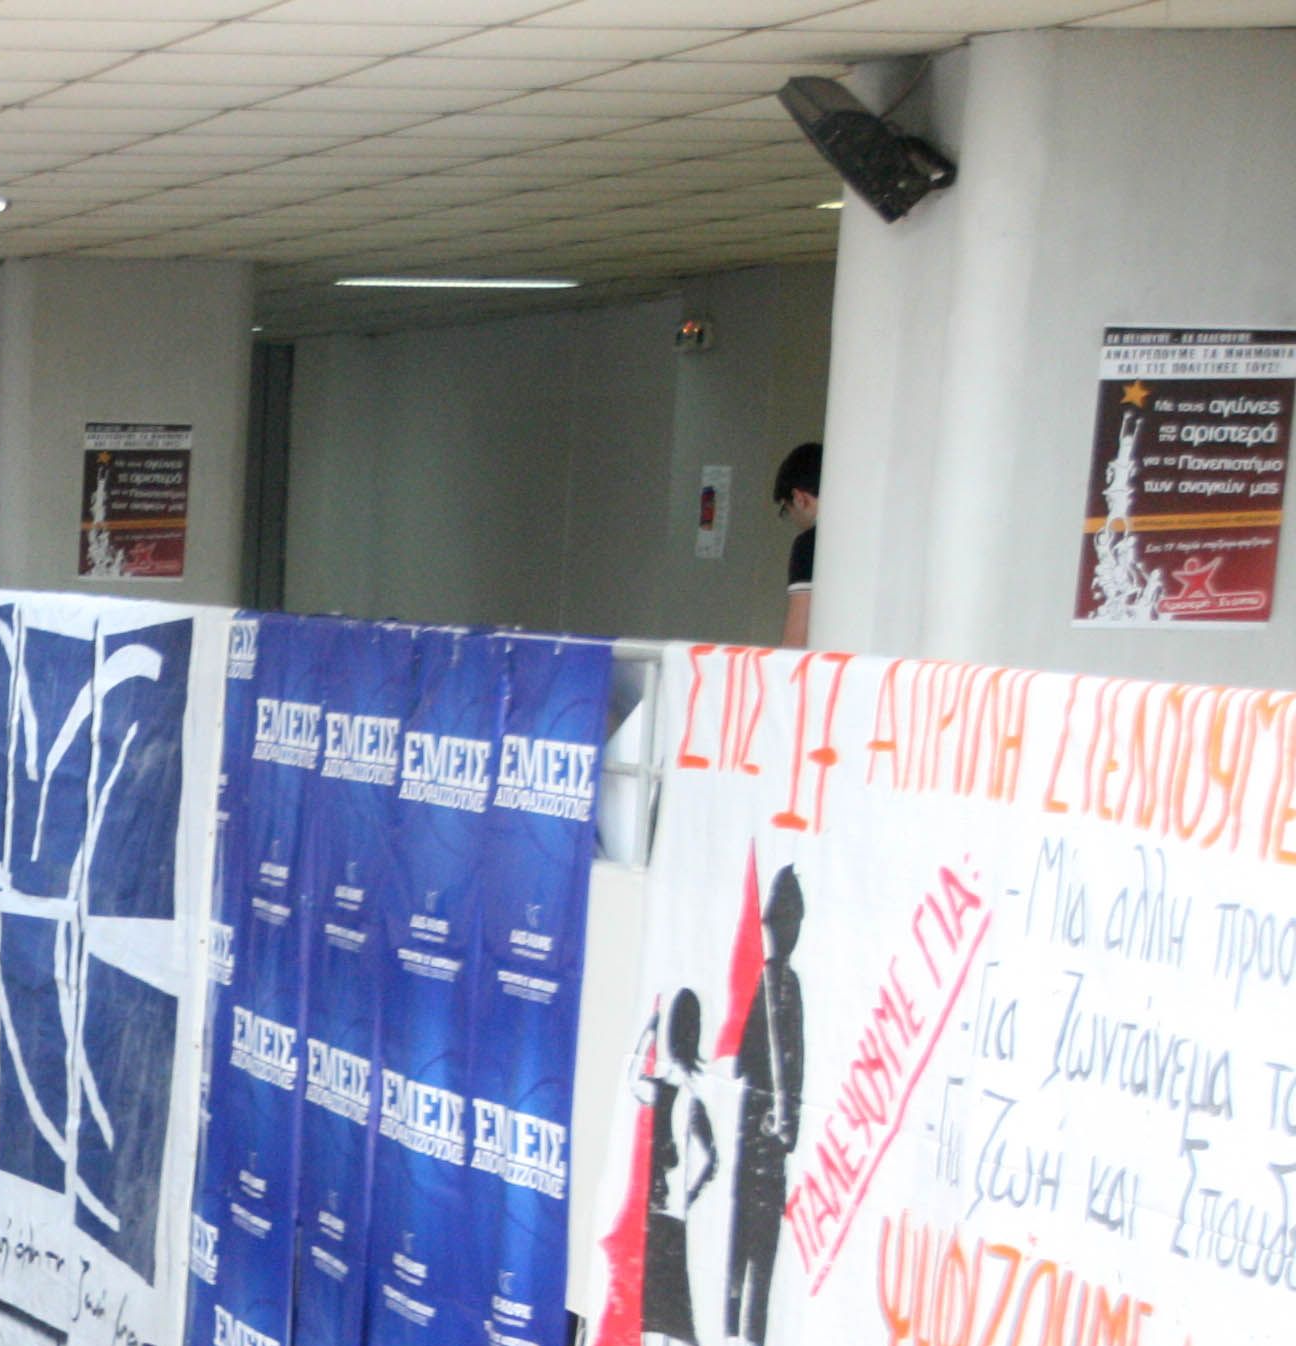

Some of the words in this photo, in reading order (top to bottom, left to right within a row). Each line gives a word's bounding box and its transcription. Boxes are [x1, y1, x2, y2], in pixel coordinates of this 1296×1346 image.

[1180, 422, 1278, 447] αριστερά
[1209, 396, 1281, 418] αγώνες
[1178, 454, 1284, 473] Πανεπιστήμιο
[1249, 481, 1280, 497] μας
[323, 712, 400, 765] ΕΜΕΙΣ
[401, 731, 491, 792] ΕΜΕΙΣ
[497, 734, 597, 799] ΕΜΕΙΣ
[677, 643, 772, 776] ΣΤΙΣ
[771, 652, 856, 835] 17
[381, 1068, 465, 1145] ΕΜΕΙΣ
[1085, 1155, 1139, 1240] και
